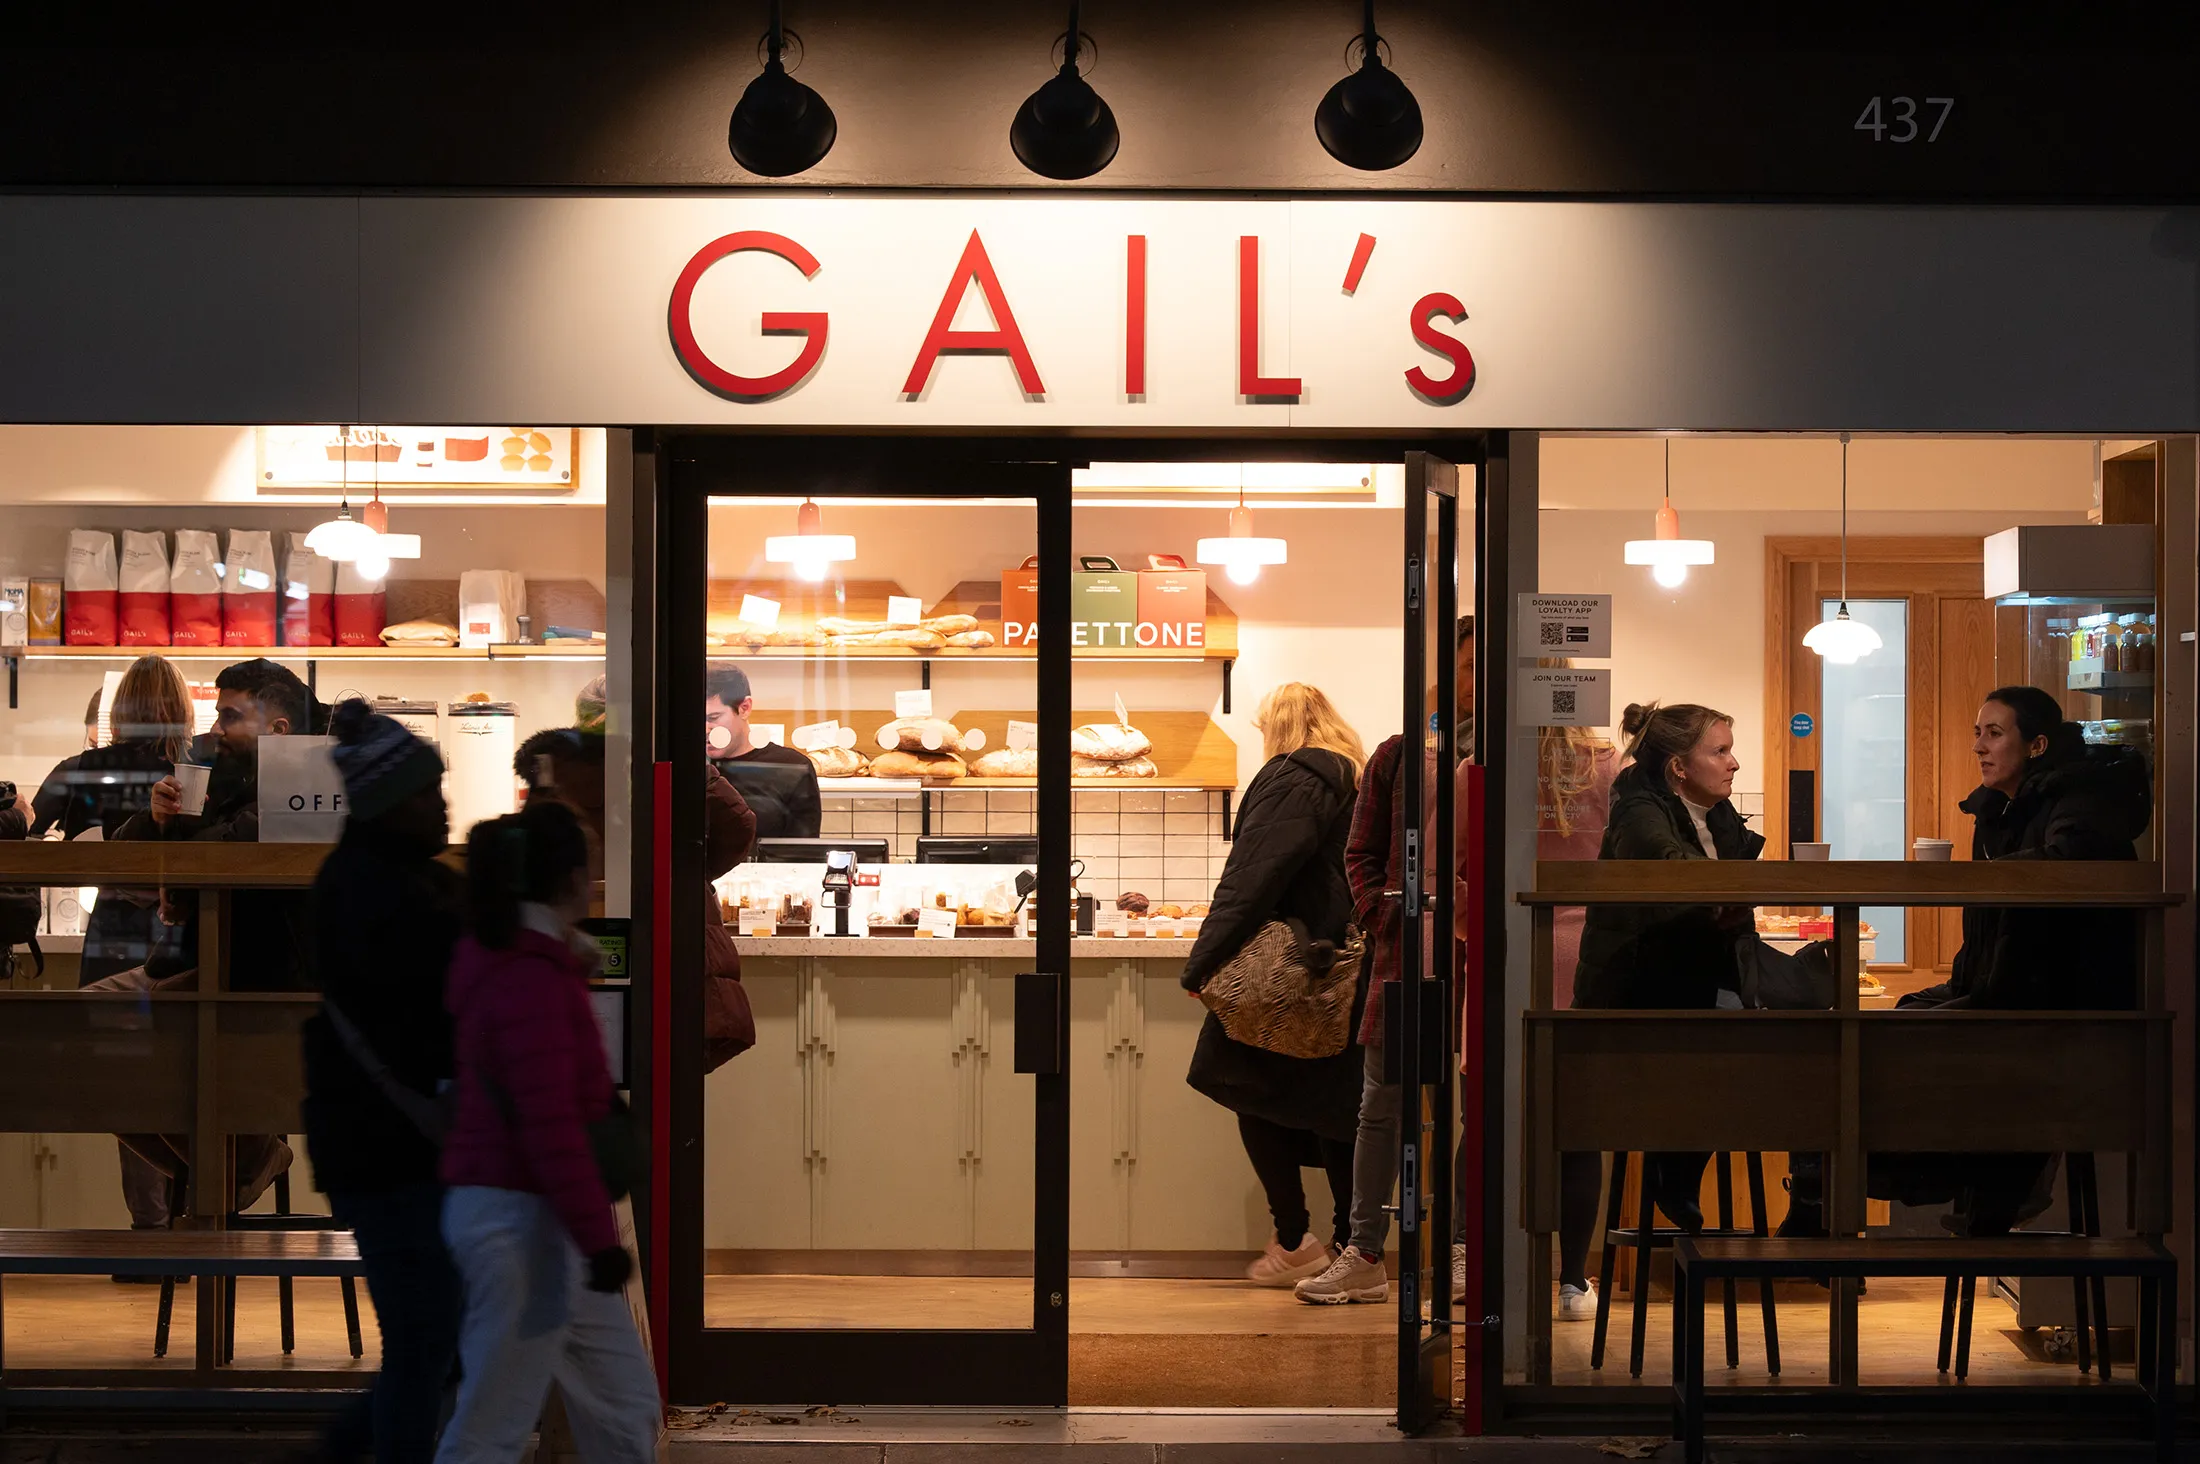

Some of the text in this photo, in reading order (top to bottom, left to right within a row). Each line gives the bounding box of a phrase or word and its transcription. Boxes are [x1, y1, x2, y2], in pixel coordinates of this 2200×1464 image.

[1854, 96, 1955, 143] 437
[669, 227, 1474, 402] GAIL's
[4, 587, 24, 597] MOMA
[1532, 599, 1579, 607] DOWNLOAD
[1003, 621, 1204, 647] PAETTONE
[610, 954, 619, 966] 5
